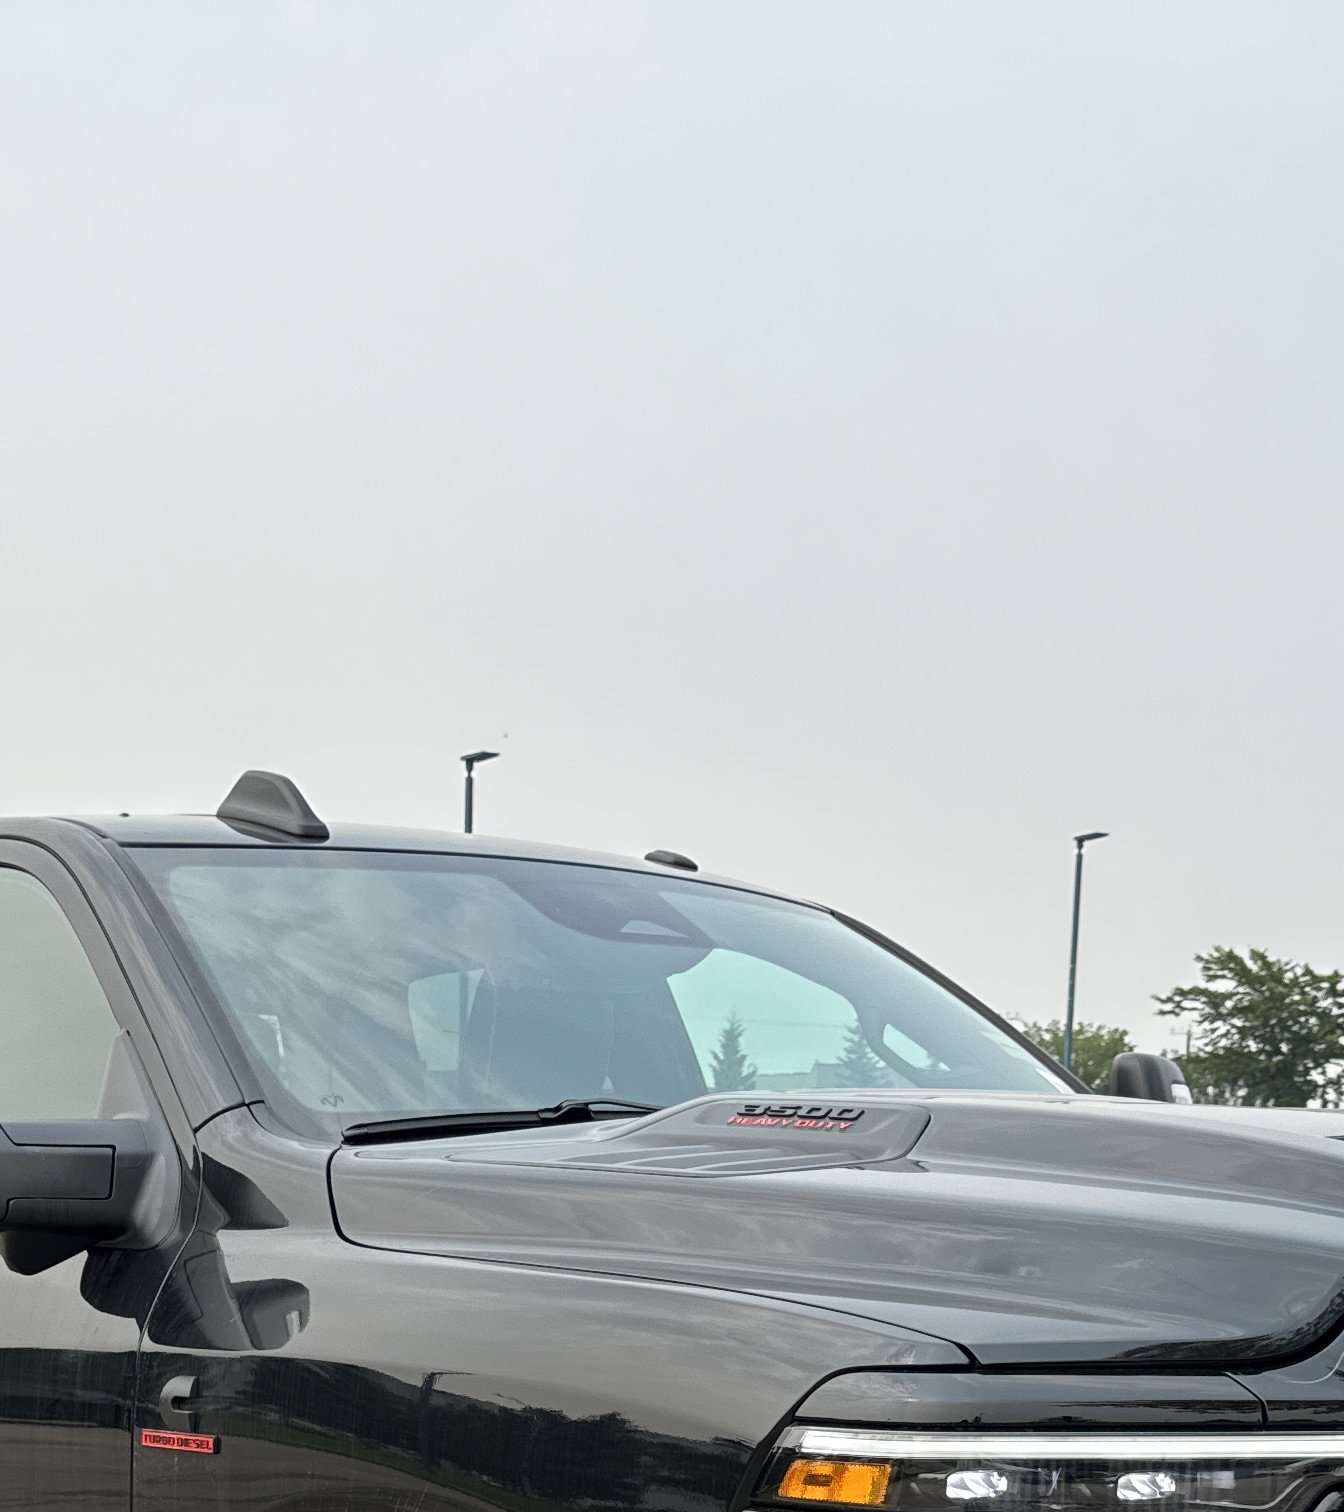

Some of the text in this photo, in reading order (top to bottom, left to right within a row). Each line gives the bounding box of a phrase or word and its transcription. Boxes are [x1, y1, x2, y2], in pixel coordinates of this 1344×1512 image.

[736, 1104, 865, 1121] 3500
[726, 1115, 854, 1130] HEAVY DUTY
[143, 1434, 212, 1450] TURBO DIESEL
